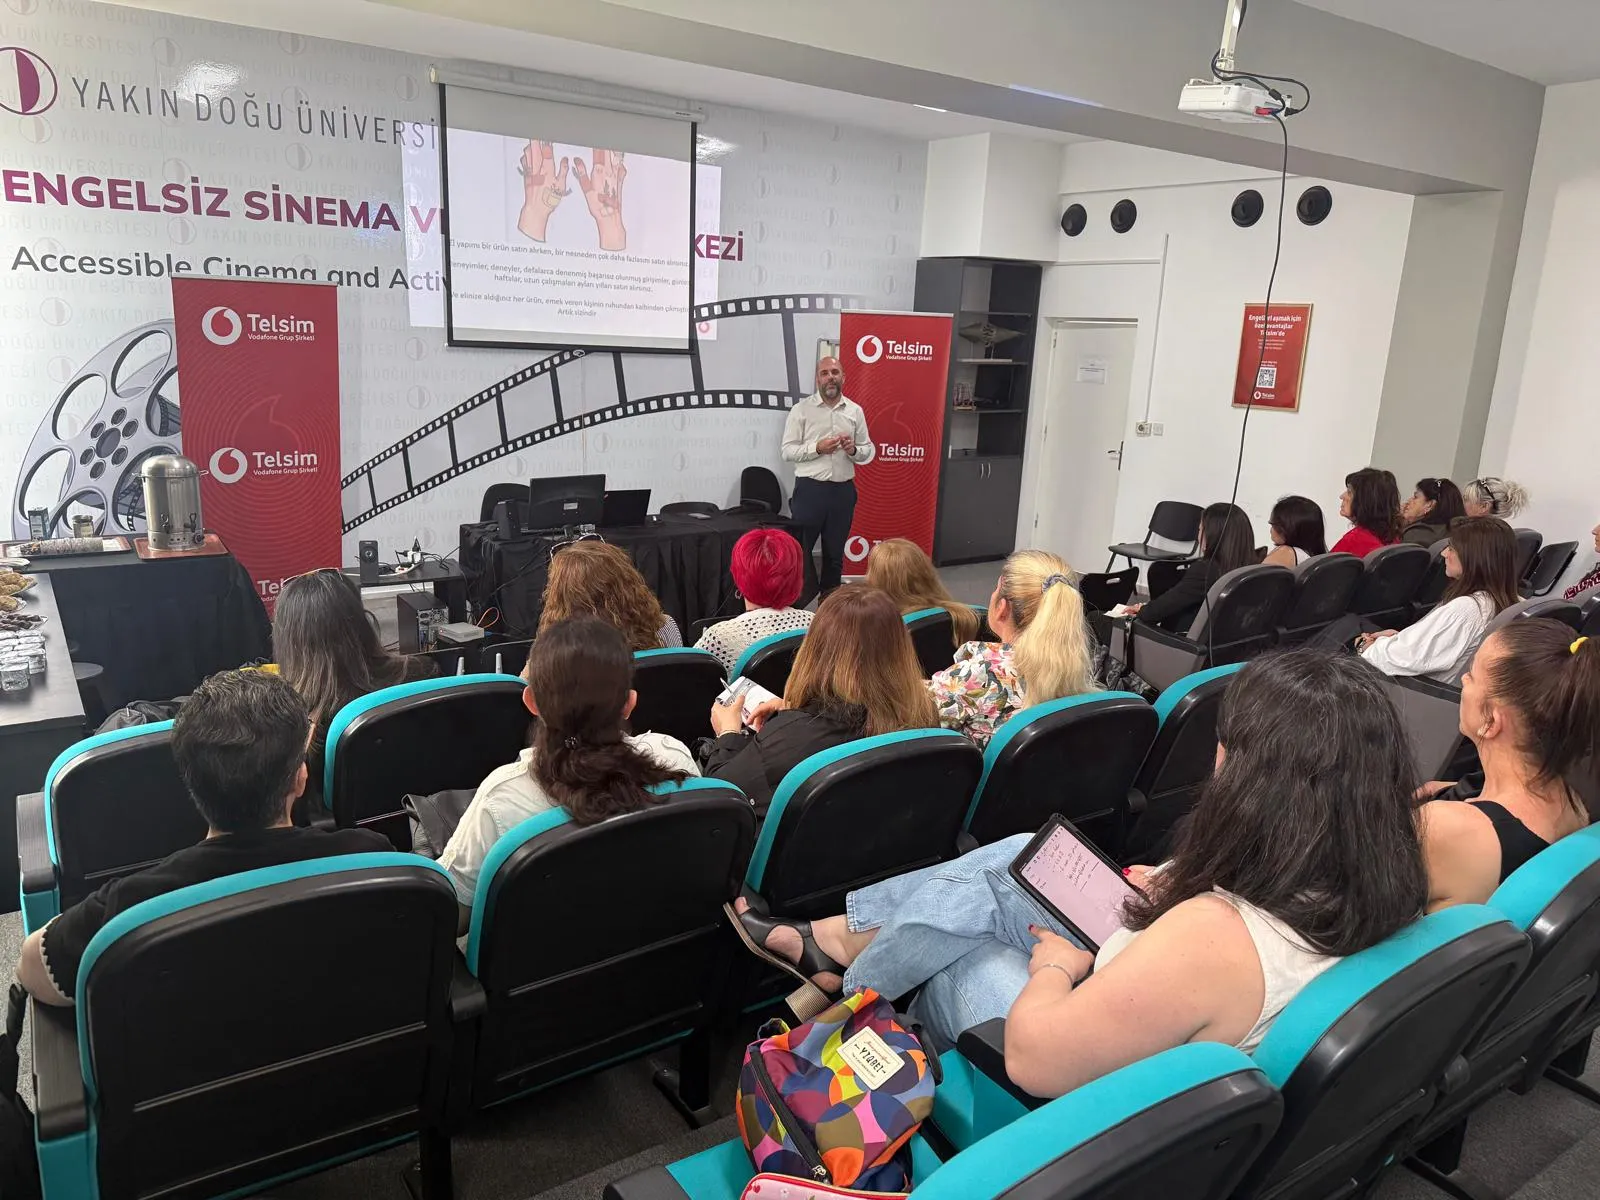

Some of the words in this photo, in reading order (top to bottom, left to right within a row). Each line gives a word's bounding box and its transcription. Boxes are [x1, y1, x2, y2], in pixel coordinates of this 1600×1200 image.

[72, 76, 178, 119] YAKIN
[195, 91, 282, 132] DOĞU
[2, 168, 231, 218] ENGELSİZ
[244, 184, 400, 231] SİNEMA
[11, 246, 192, 277] Accessible
[246, 313, 315, 334] Telsim
[247, 333, 278, 342] Vodafone
[887, 340, 933, 355] Telsim
[252, 450, 318, 468] Telsim
[879, 443, 925, 457] Telsim
[253, 468, 283, 476] Vodafone
